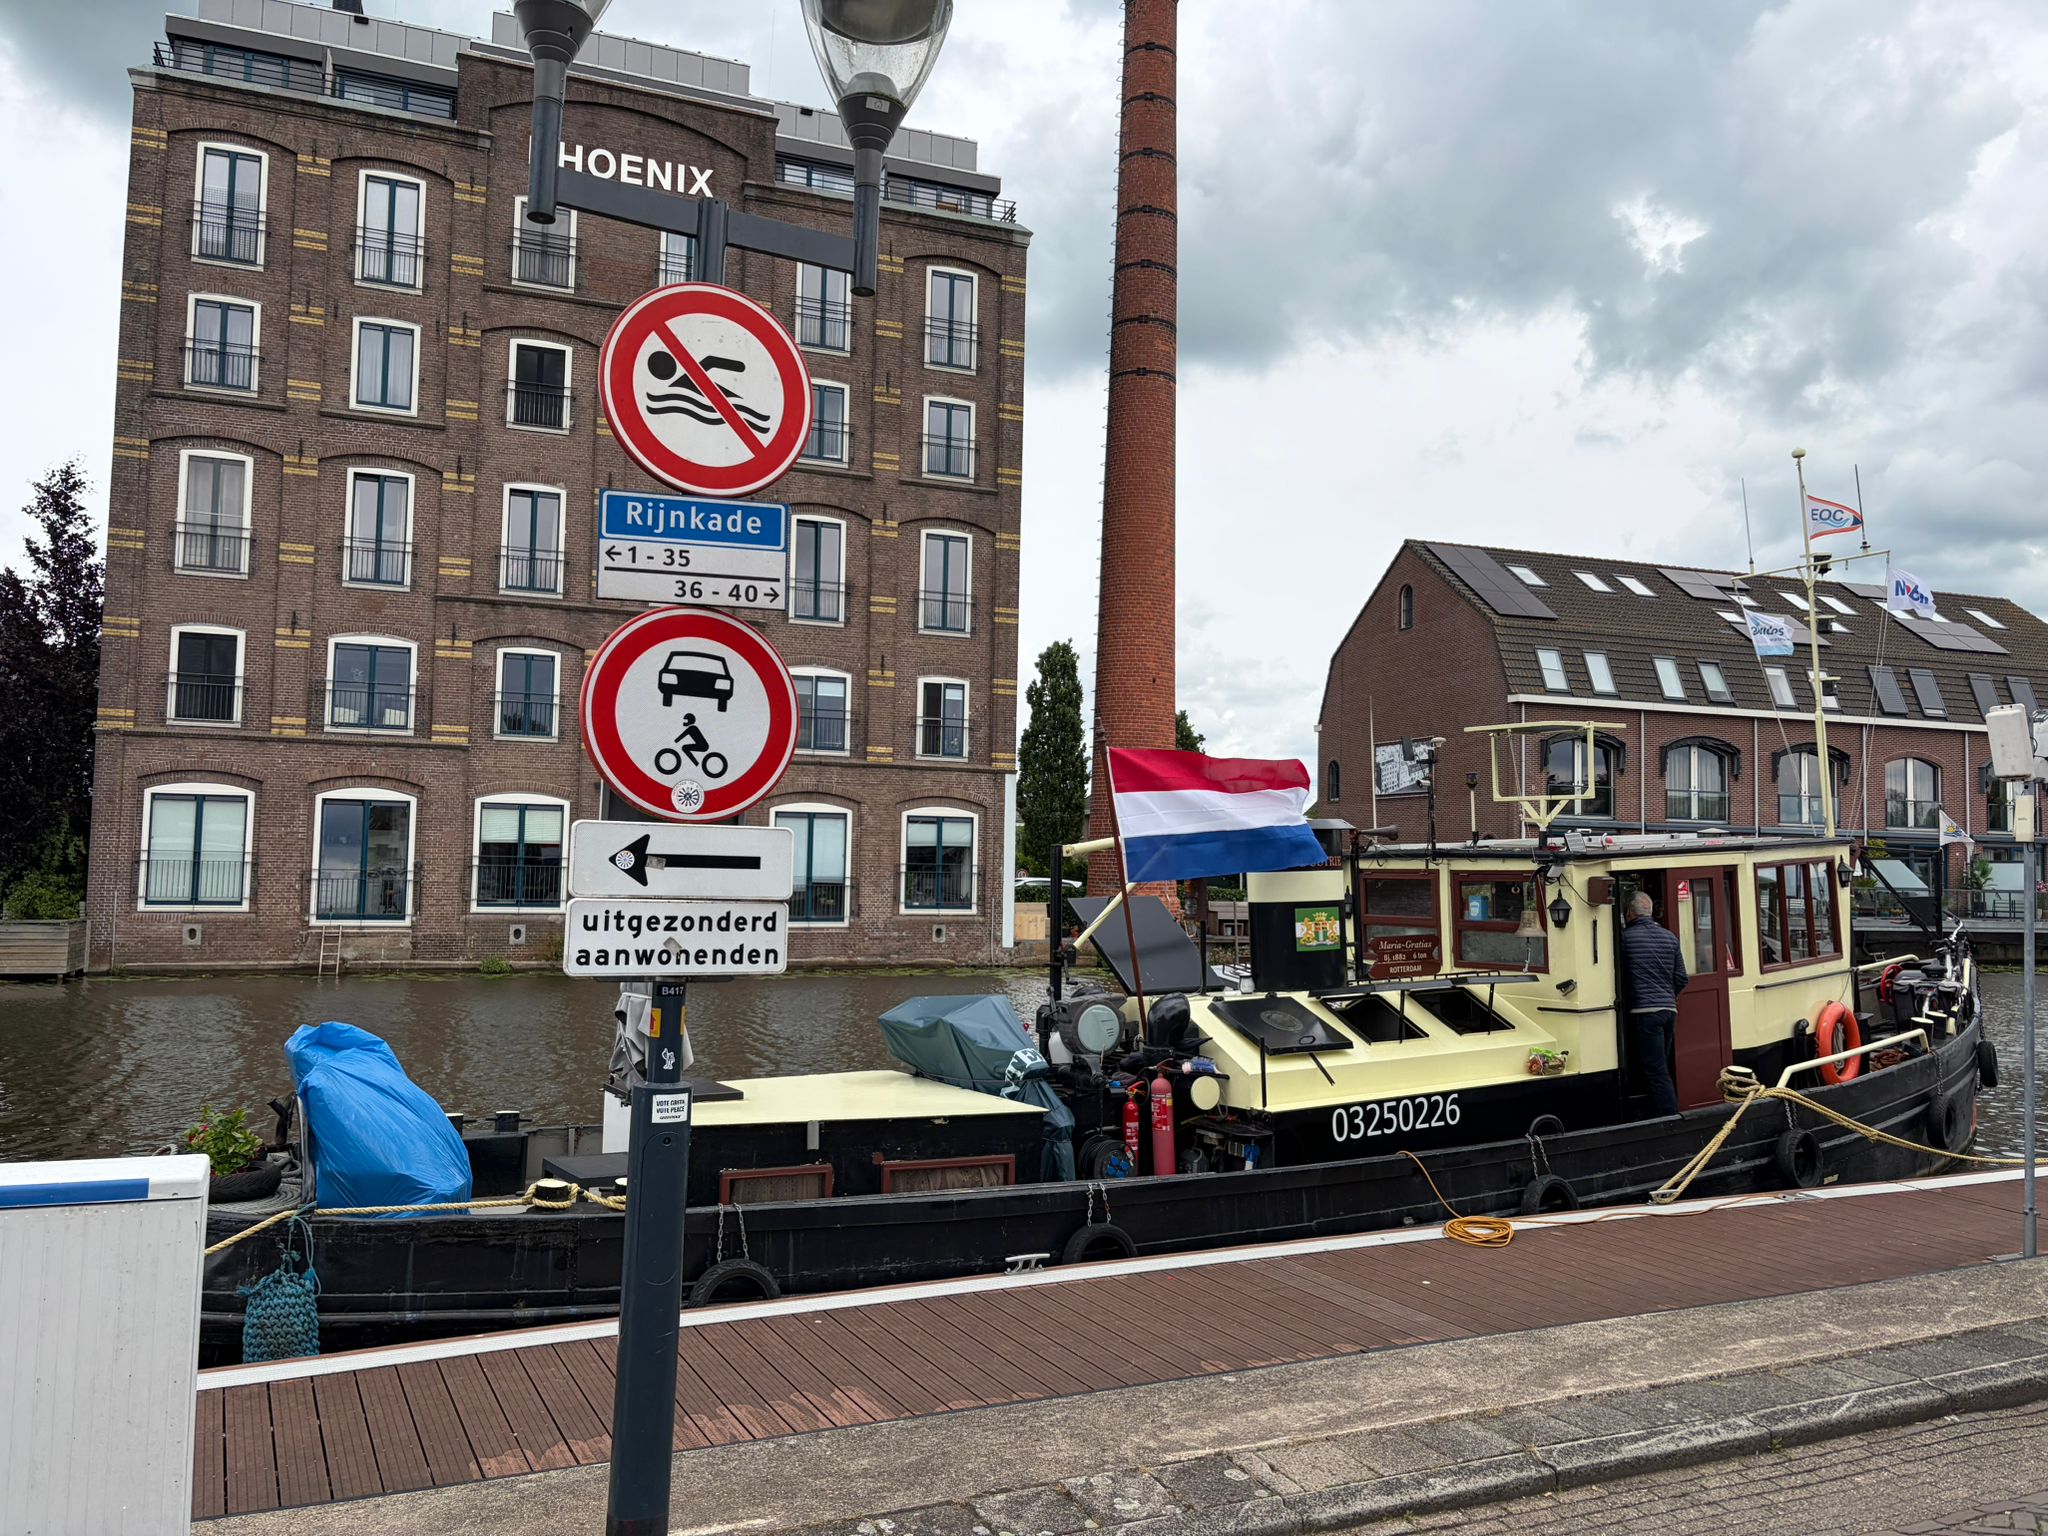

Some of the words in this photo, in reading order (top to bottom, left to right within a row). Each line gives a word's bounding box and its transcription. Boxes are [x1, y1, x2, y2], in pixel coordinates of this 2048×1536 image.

[529, 136, 714, 198] HOENIX
[626, 501, 763, 535] Rijnkade
[1811, 508, 1845, 521] EOC
[582, 909, 777, 939] uitgezonderd
[575, 943, 779, 967] aanwonenden
[1389, 964, 1423, 974] ROTTERDAM
[661, 986, 685, 996] B417
[1332, 1093, 1461, 1142] 03250226
